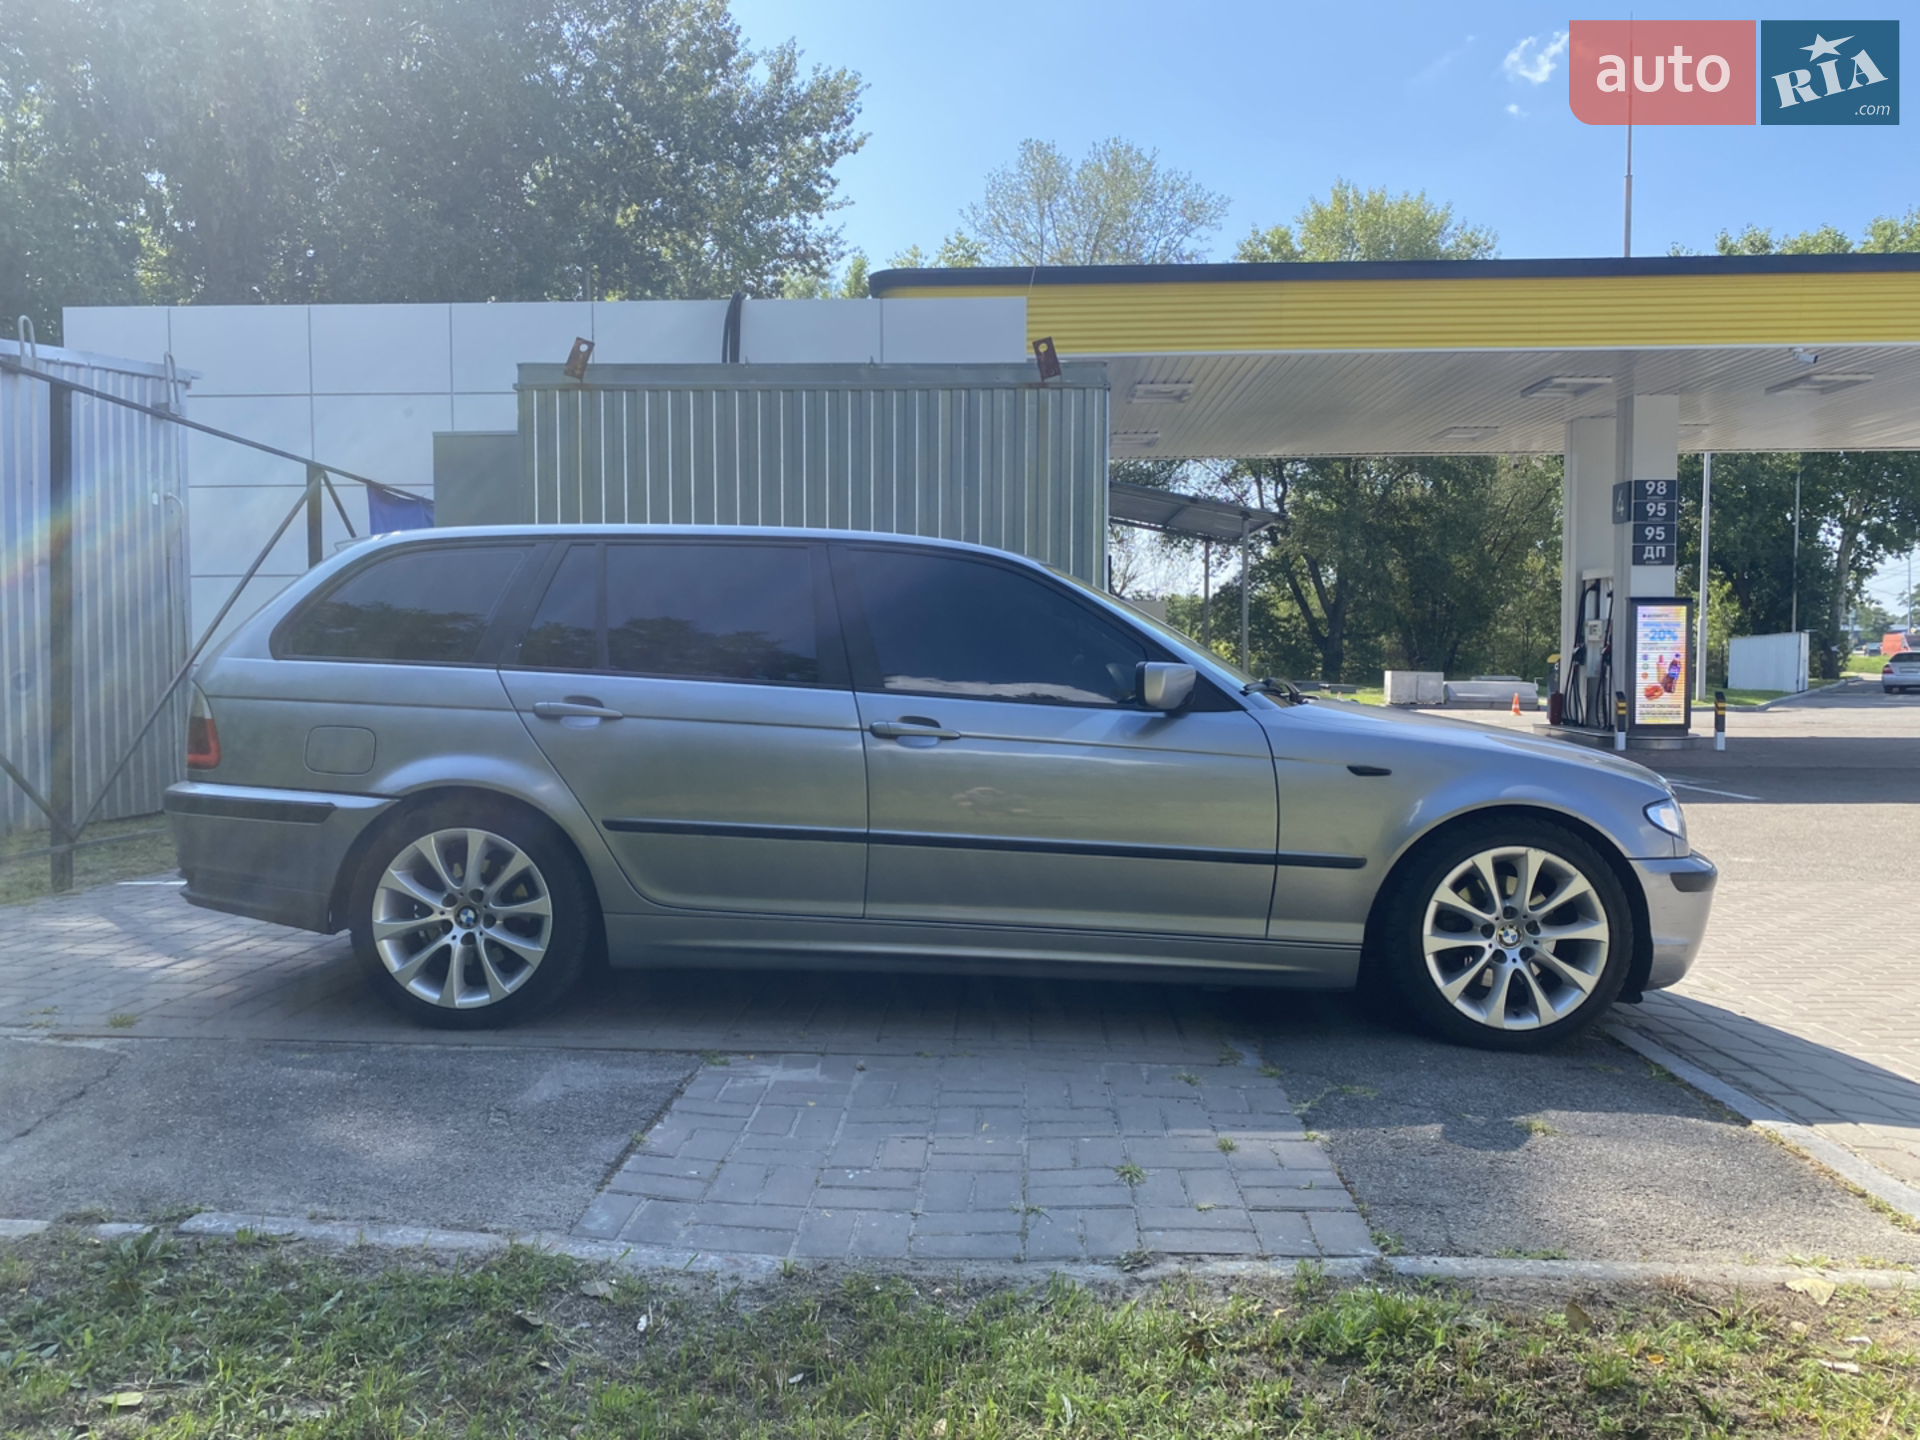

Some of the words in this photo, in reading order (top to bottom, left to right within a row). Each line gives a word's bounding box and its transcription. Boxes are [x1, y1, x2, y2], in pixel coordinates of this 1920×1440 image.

[1645, 481, 1667, 495] 98
[1616, 489, 1625, 517] 4
[1646, 502, 1667, 517] 95
[1644, 526, 1666, 541] 95
[1643, 546, 1666, 560] ДП
